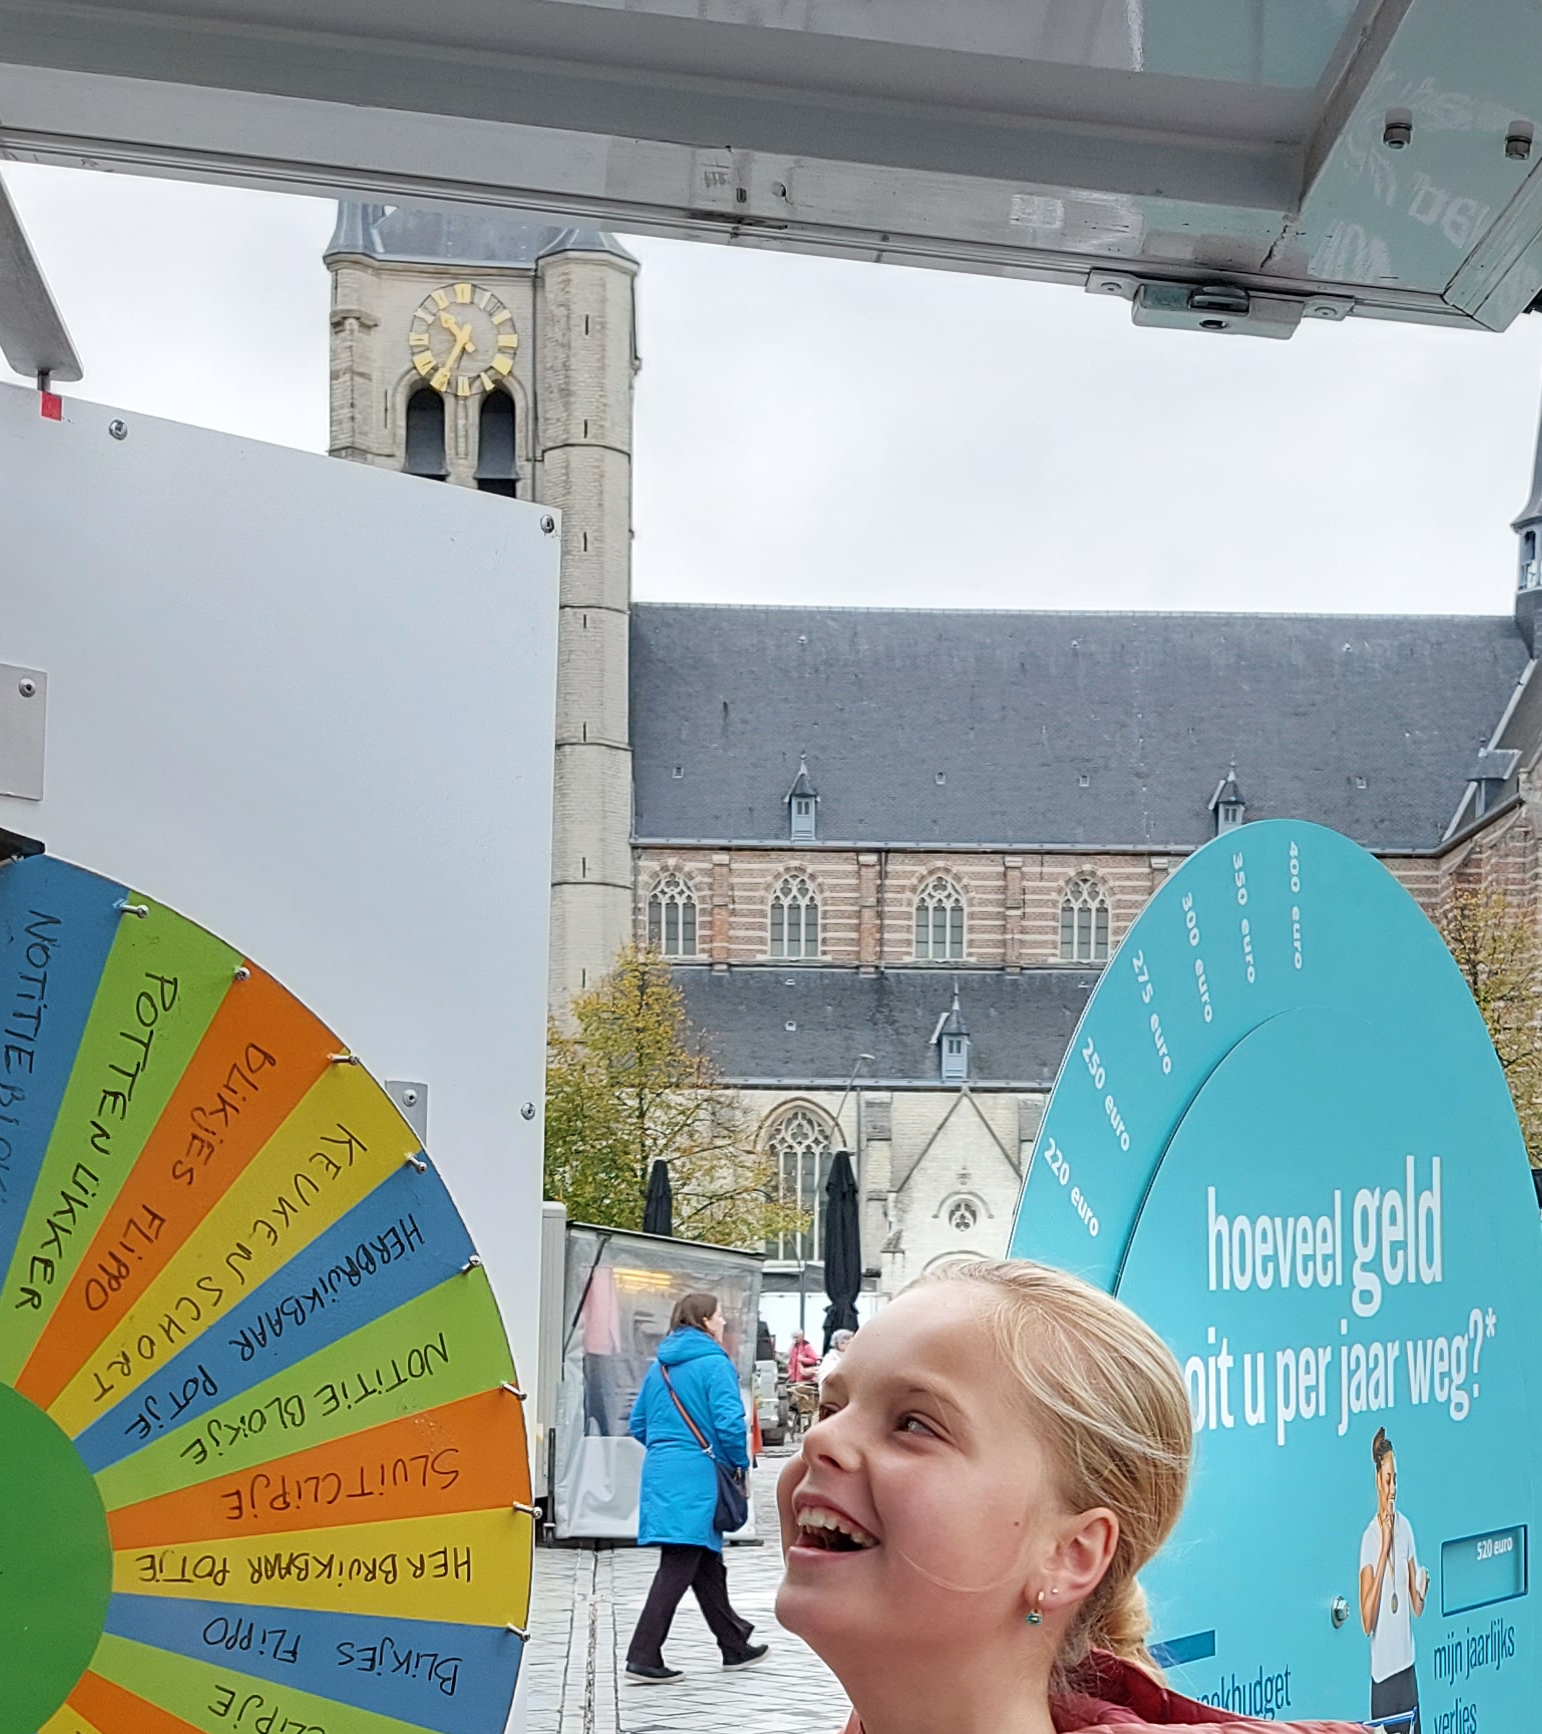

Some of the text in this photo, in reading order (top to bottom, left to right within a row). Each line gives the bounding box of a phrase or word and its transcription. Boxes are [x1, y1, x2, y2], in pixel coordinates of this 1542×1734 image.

[1180, 892, 1214, 1023] 300 euro
[1231, 851, 1256, 984] 350 euro
[1288, 841, 1303, 970] 400 euro
[1132, 949, 1172, 1075] 275 euro
[1081, 1037, 1131, 1152] 250 euro
[1043, 1138, 1100, 1237] 220 euro
[1207, 1155, 1443, 1318] hoeveel geld
[1183, 1325, 1235, 1434] oit
[1243, 1351, 1267, 1428] u
[1277, 1344, 1333, 1446] per
[1337, 1319, 1400, 1436] jaar
[1476, 1536, 1513, 1561] 520 euro
[1196, 1663, 1292, 1721] kbudget
[1433, 1617, 1516, 1687] mijn jaarlijks
